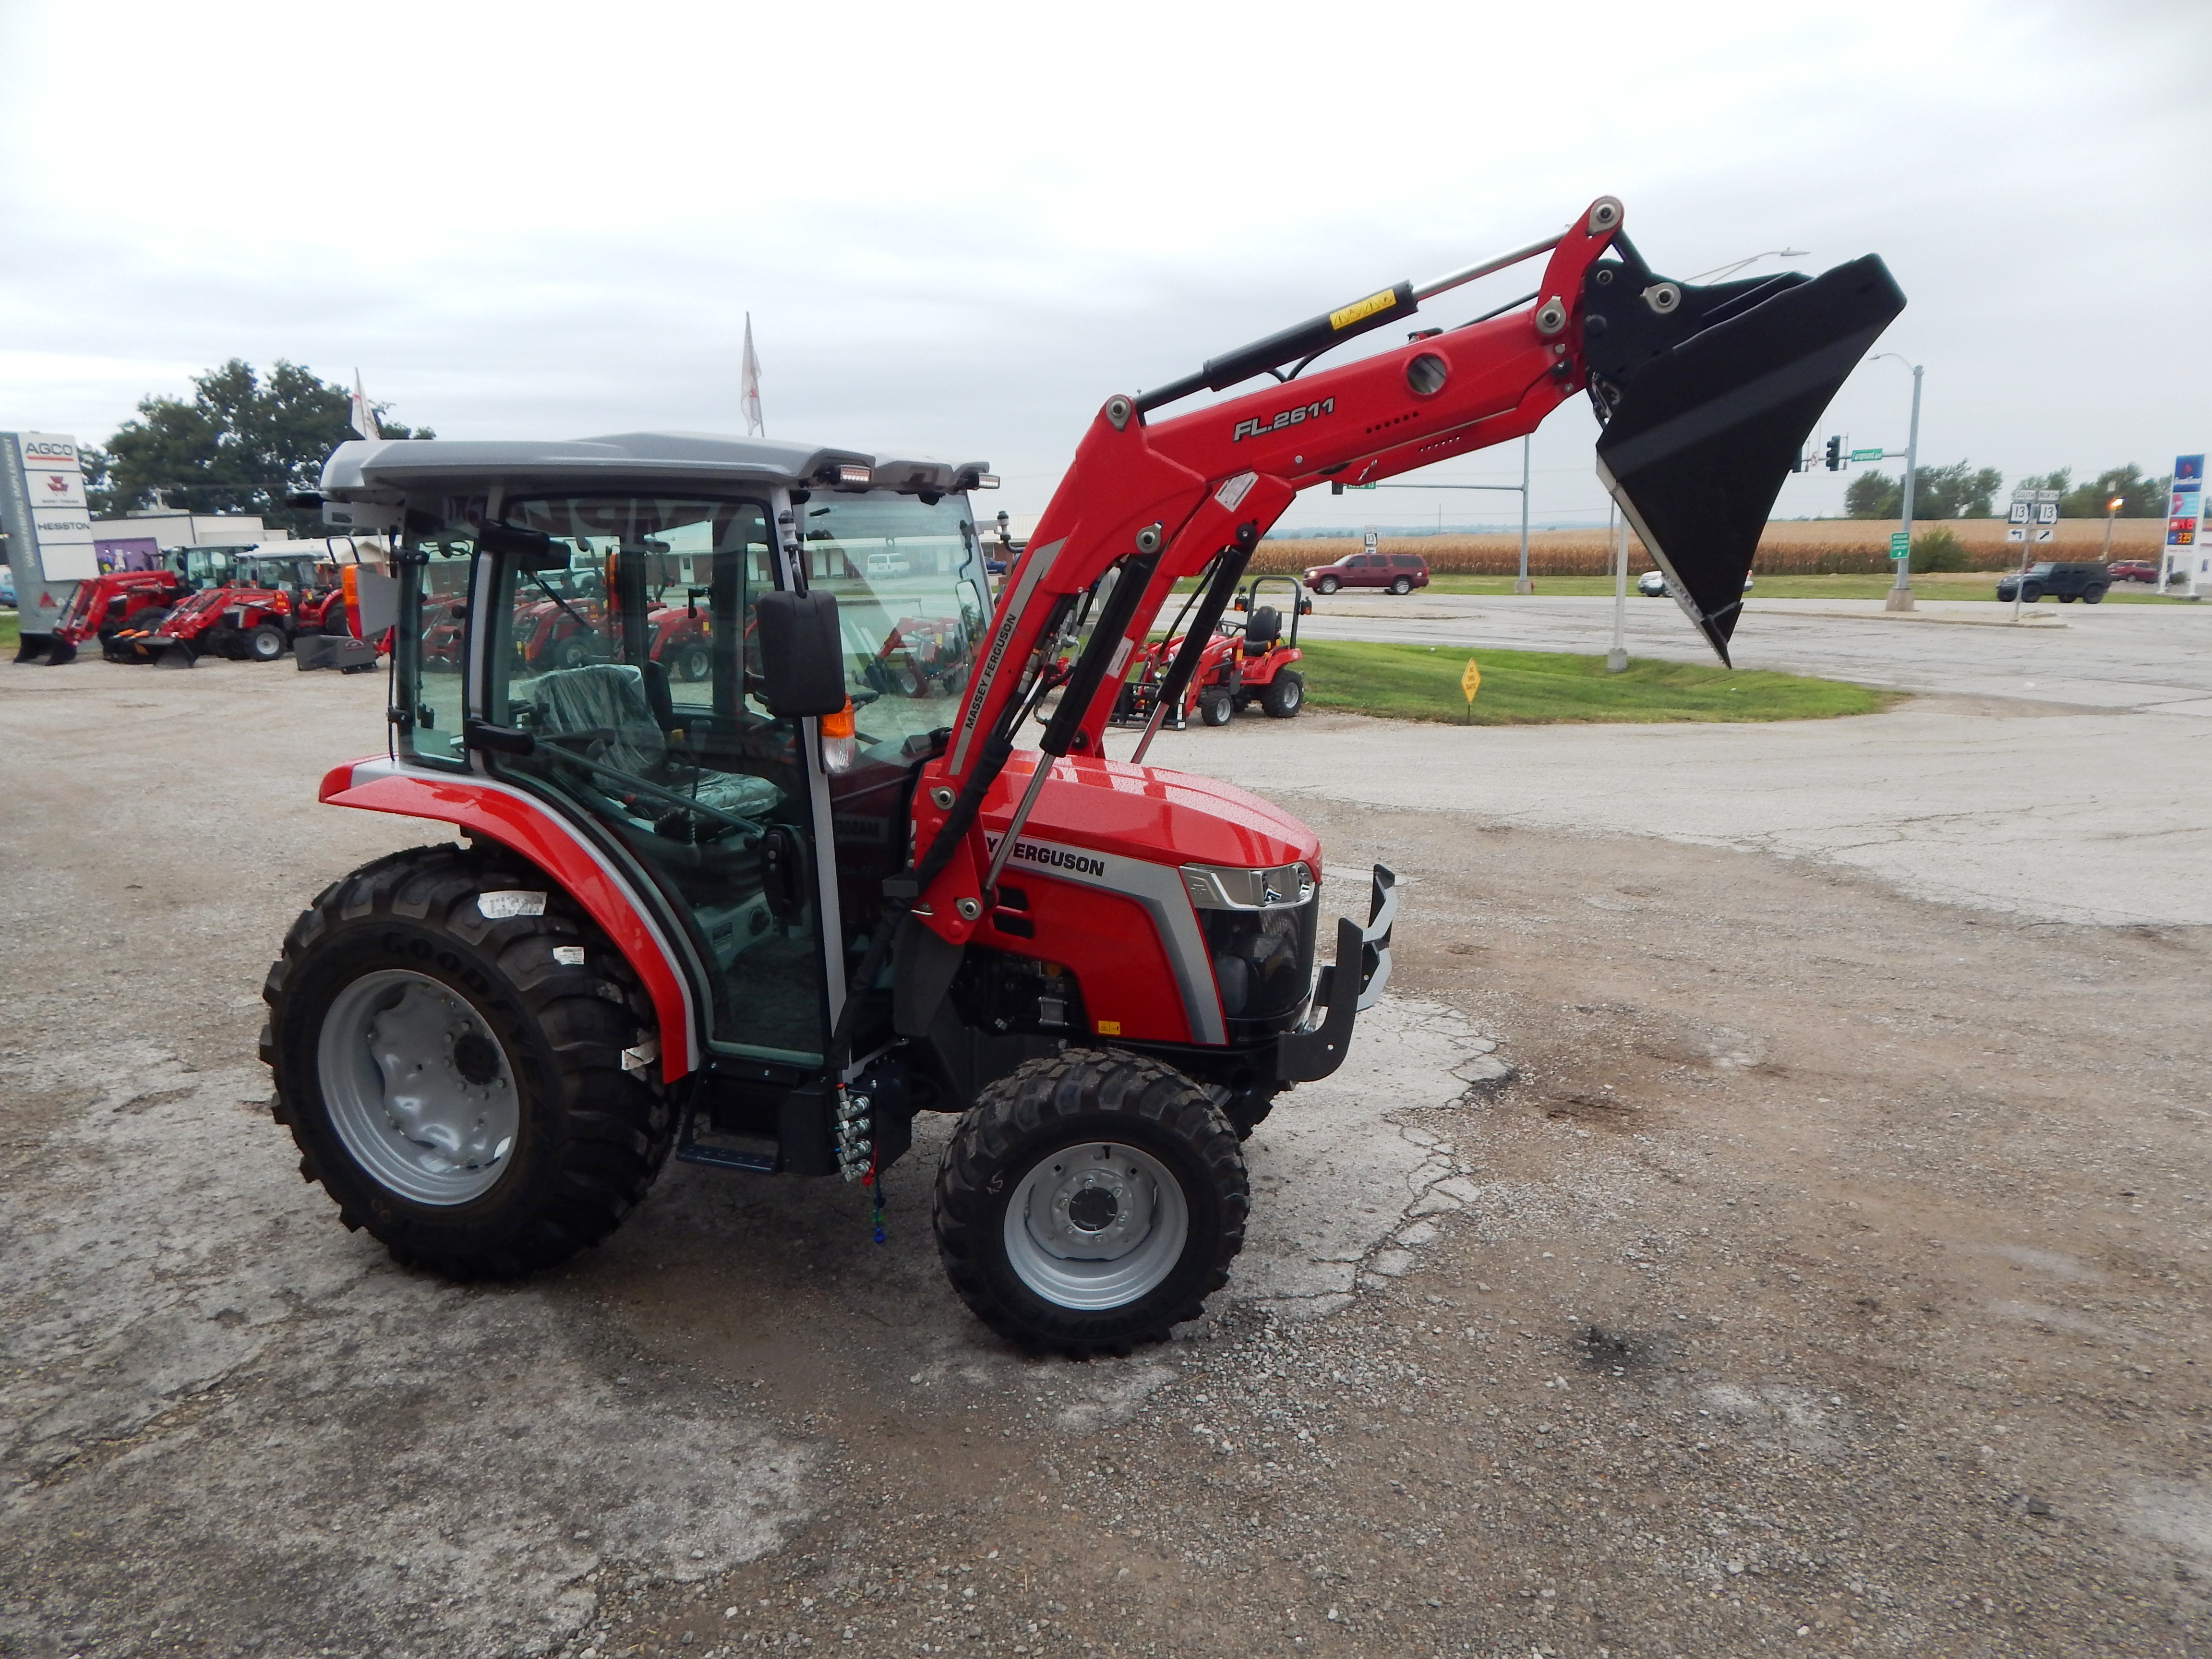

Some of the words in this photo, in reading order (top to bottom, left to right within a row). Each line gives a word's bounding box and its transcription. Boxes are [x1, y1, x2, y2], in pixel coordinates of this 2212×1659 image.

[1233, 397, 1334, 442] FL.2611
[25, 442, 73, 456] AGCO
[2015, 506, 2025, 517] 13
[2043, 507, 2054, 518] 13
[965, 679, 988, 729] MASSEY
[985, 613, 1016, 678] FERGUSON
[1013, 842, 1105, 877] ERGUSON
